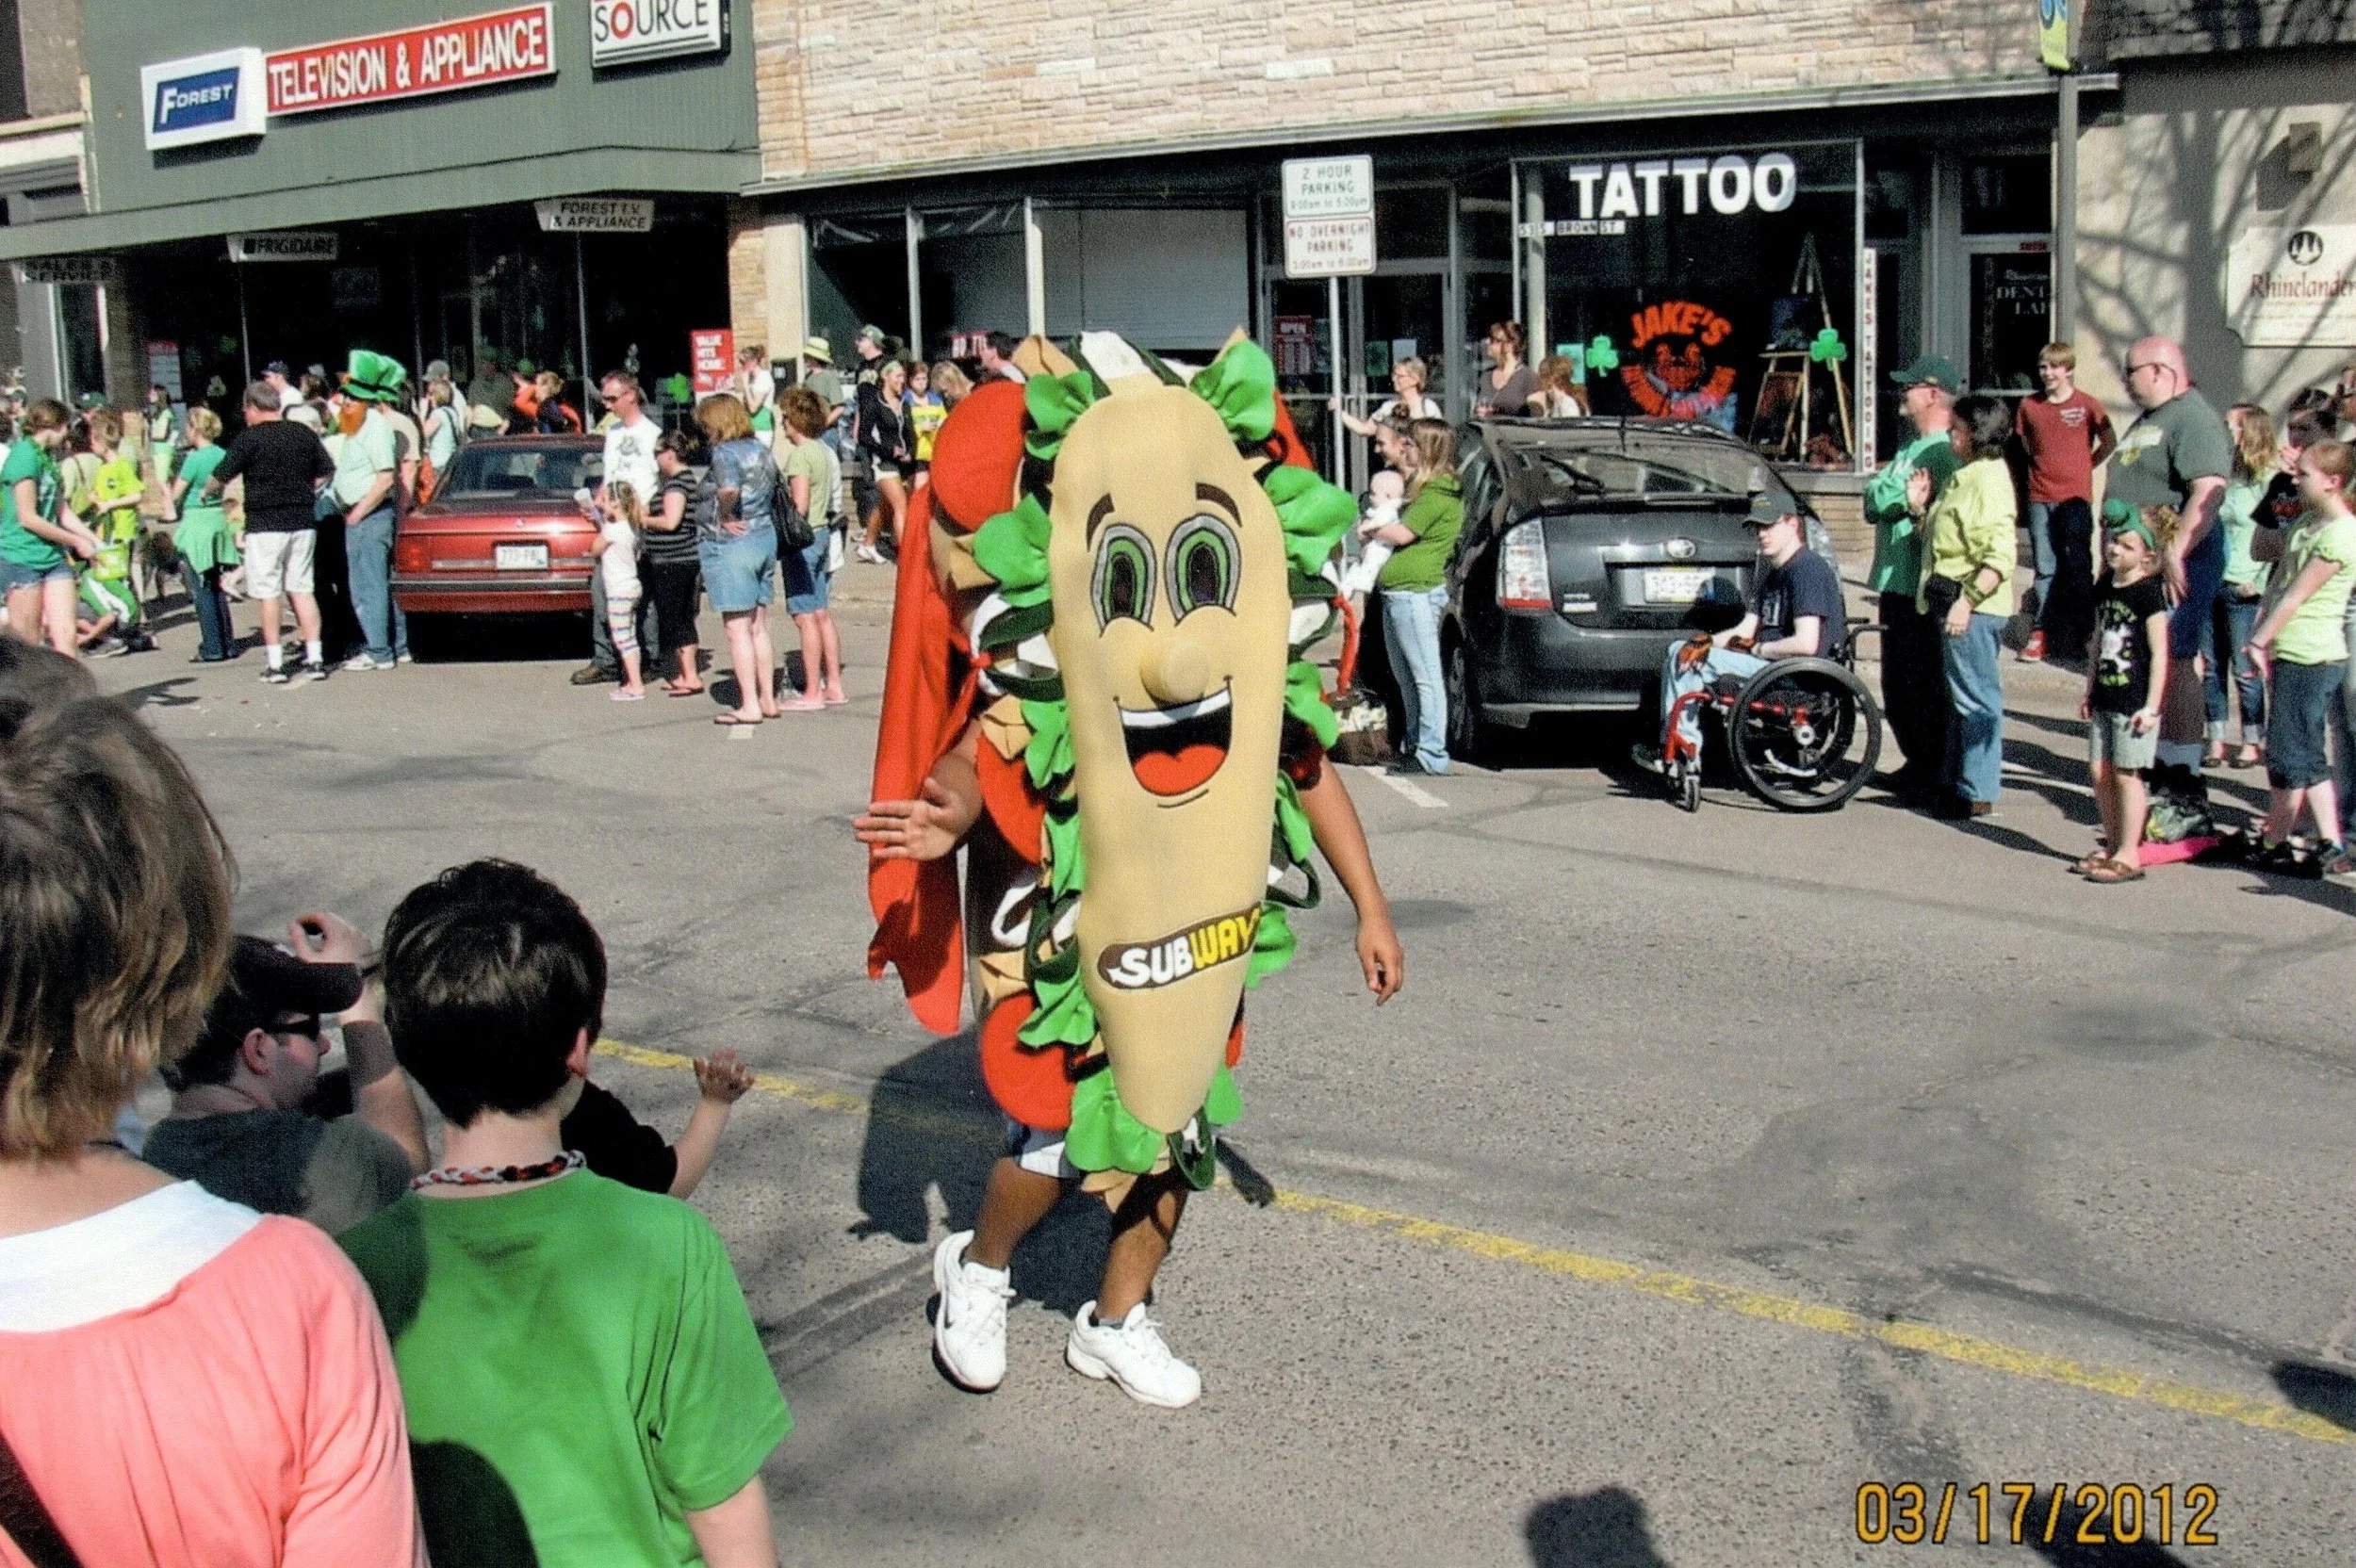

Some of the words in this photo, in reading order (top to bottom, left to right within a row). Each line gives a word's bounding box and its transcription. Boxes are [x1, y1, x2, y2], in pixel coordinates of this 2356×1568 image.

[594, 0, 711, 42] SOURCE
[268, 46, 387, 106] TELEVISION
[394, 41, 412, 88] &
[419, 16, 544, 83] APPLIANCE
[1302, 167, 1311, 180] 2
[1317, 164, 1352, 178] HOUR
[1301, 179, 1354, 195] PARKING
[1568, 152, 1796, 219] TATTOO
[560, 201, 617, 215] FOREST
[553, 216, 563, 227] &
[567, 215, 646, 229] APPLIANCE
[1289, 226, 1303, 239] NO
[1310, 221, 1370, 237] OVERNIGHT
[1558, 220, 1597, 234] BROWN
[1602, 220, 1616, 233] ST
[255, 236, 336, 254] FRIGIDAIRE
[1306, 237, 1353, 253] PARKING
[1864, 253, 1873, 325] JAKES
[1996, 286, 2051, 299] DENT
[2250, 270, 2356, 299] Rhinelander
[1631, 301, 1732, 349] JAKE'S
[1864, 335, 1873, 468] TATTOOING
[1106, 907, 1261, 987] SUBWAY
